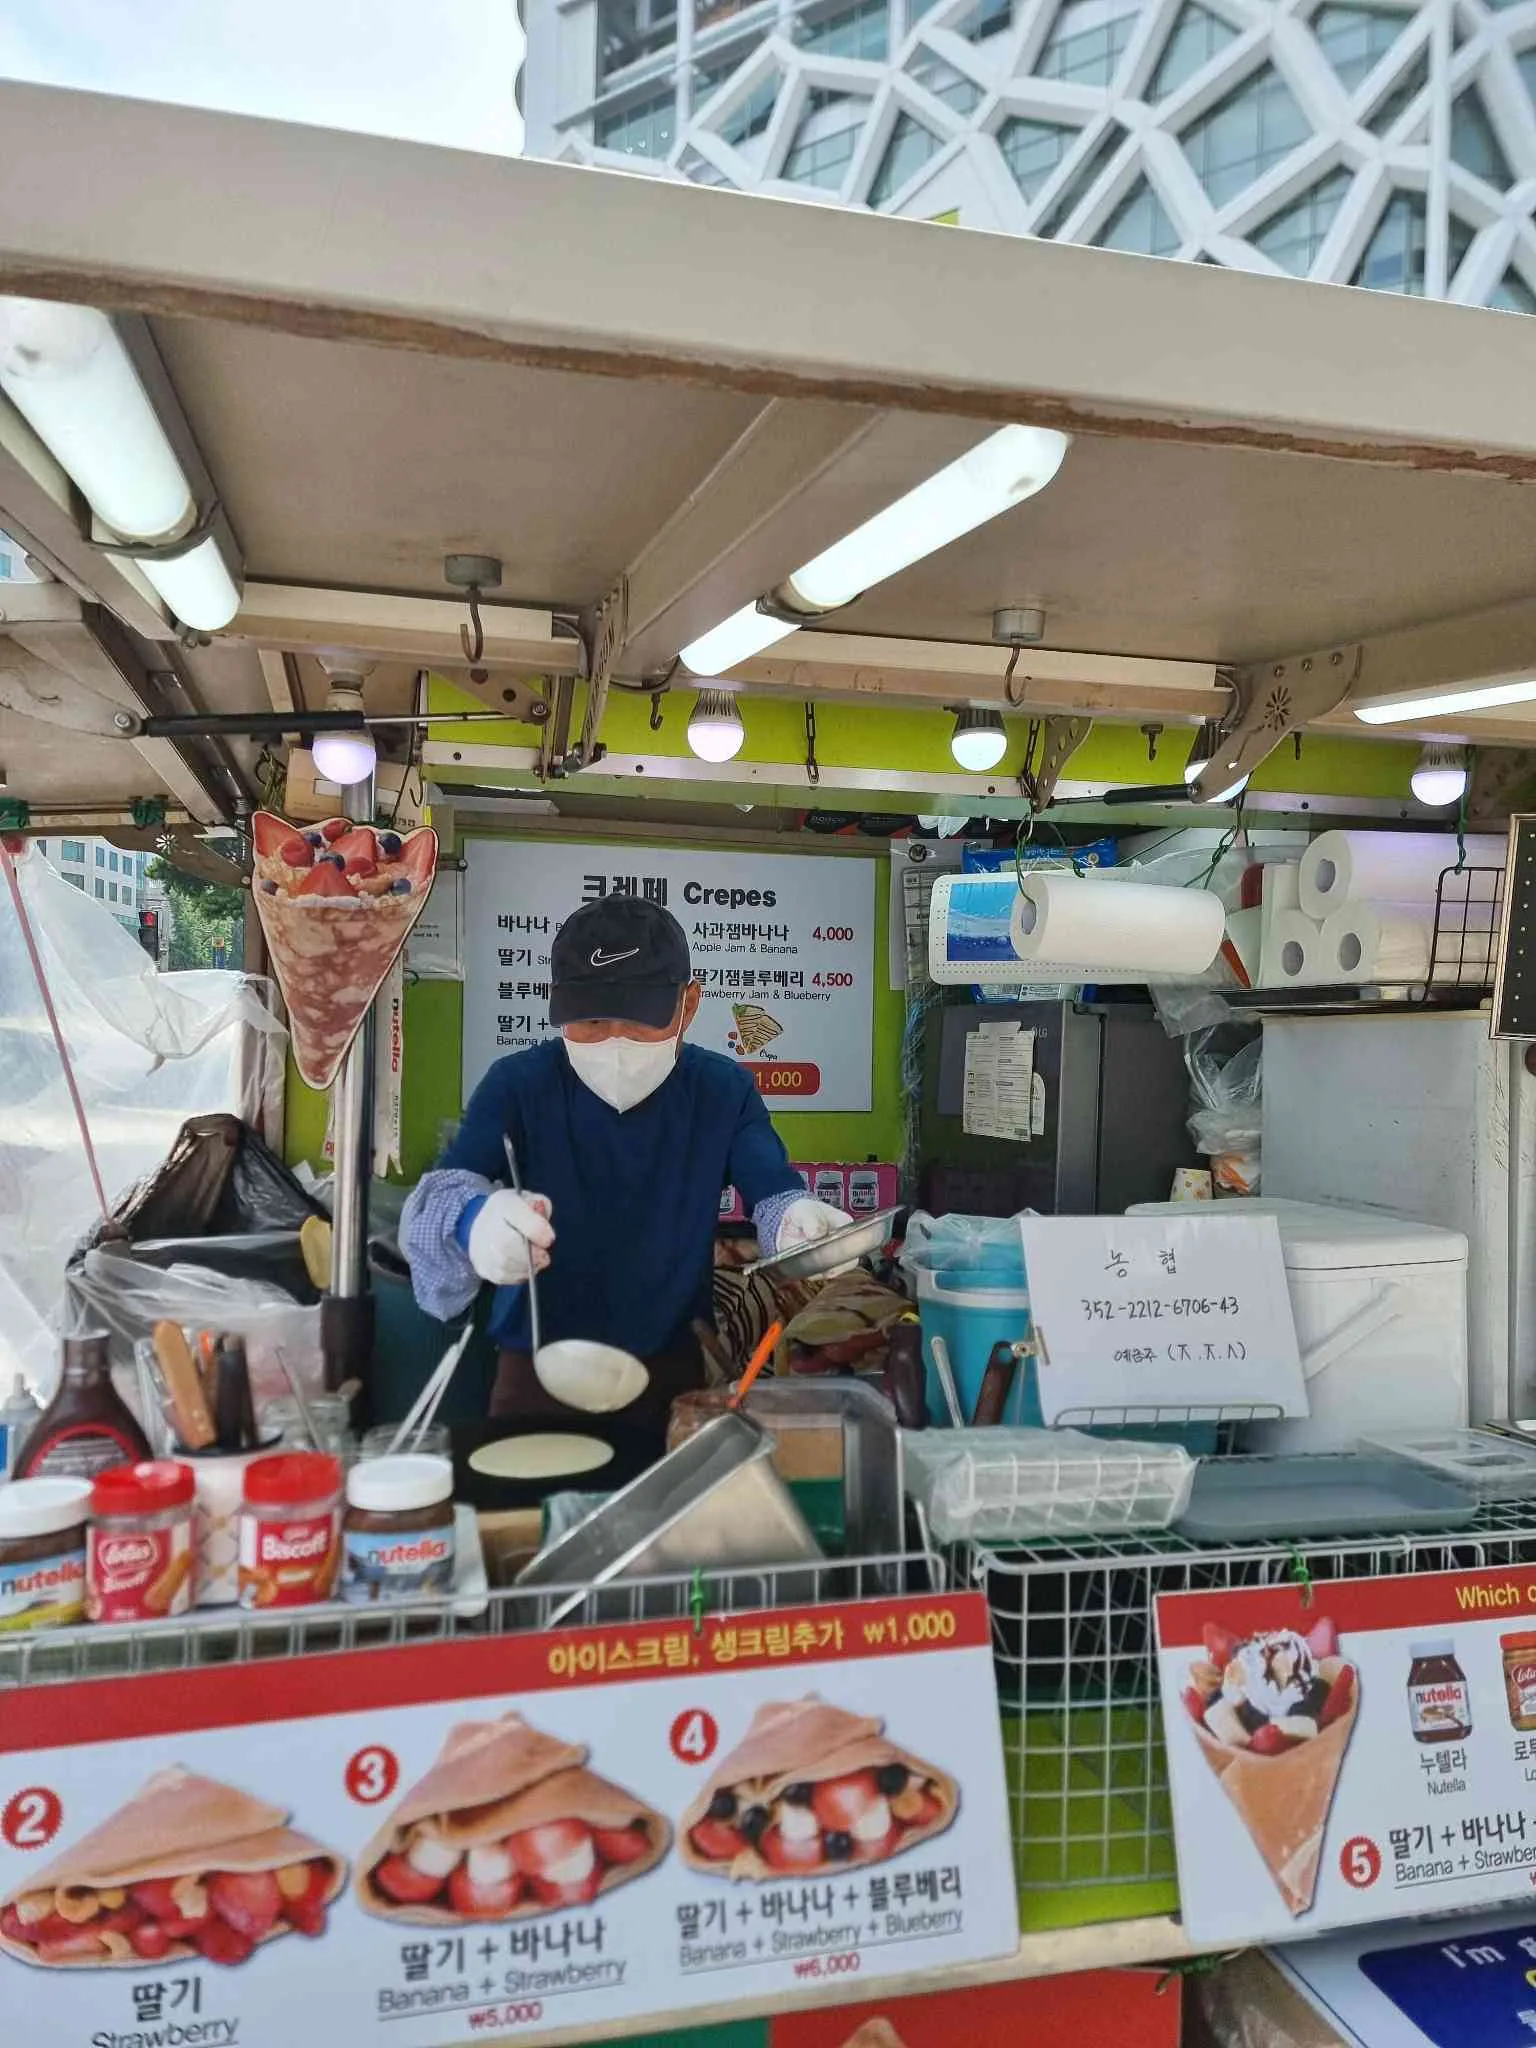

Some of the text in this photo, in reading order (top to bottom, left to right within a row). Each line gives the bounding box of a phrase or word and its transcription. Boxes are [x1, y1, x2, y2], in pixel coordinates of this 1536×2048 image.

[581, 875, 777, 909] 크레페 Crepes
[497, 915, 550, 933] 바나나
[692, 922, 854, 942] 사과잼바나나 4,000
[498, 949, 532, 966] 딸기
[692, 943, 798, 954] Apple Jam & Banana
[497, 982, 549, 1000] 블루베
[693, 968, 853, 987] 딸기잼블루베리 4,500
[700, 990, 831, 1001] rawberry Jam & Blueberry
[391, 998, 401, 1072] nutella
[498, 1015, 531, 1032] 딸기
[497, 1036, 539, 1046] Banana
[755, 1071, 802, 1088] 1,000
[368, 1538, 448, 1565] nutella
[1455, 1583, 1520, 1609] Which
[547, 1635, 699, 1678] 아이스크림,
[711, 1619, 845, 1662] 생크림추가
[1415, 1687, 1462, 1705] nutella
[679, 1715, 707, 1756] 4
[1420, 1748, 1468, 1776] 누텔라
[356, 1754, 387, 1799] 3
[1427, 1778, 1466, 1795] Nutella
[15, 1795, 48, 1845] 2
[1389, 1825, 1434, 1860] 딸기
[1462, 1811, 1527, 1847] 바나나
[1351, 1843, 1372, 1883] 5
[1396, 1859, 1454, 1882] Banana
[1474, 1846, 1536, 1870] Strawber
[677, 1899, 727, 1940] 딸기
[761, 1884, 835, 1926] 바나나
[868, 1866, 964, 1912] 블루베리
[400, 1936, 465, 1982] 딸기
[510, 1916, 606, 1962] 바나나
[679, 1938, 748, 1968] Banana
[771, 1924, 862, 1953] Strawberry
[885, 1907, 964, 1937] Blueberry
[1441, 1944, 1506, 1968] I'm
[132, 1976, 202, 2022] 딸기
[378, 1981, 470, 2013] Banana
[504, 1958, 627, 1995] Strawberry
[91, 2017, 240, 2048] Strawberry
